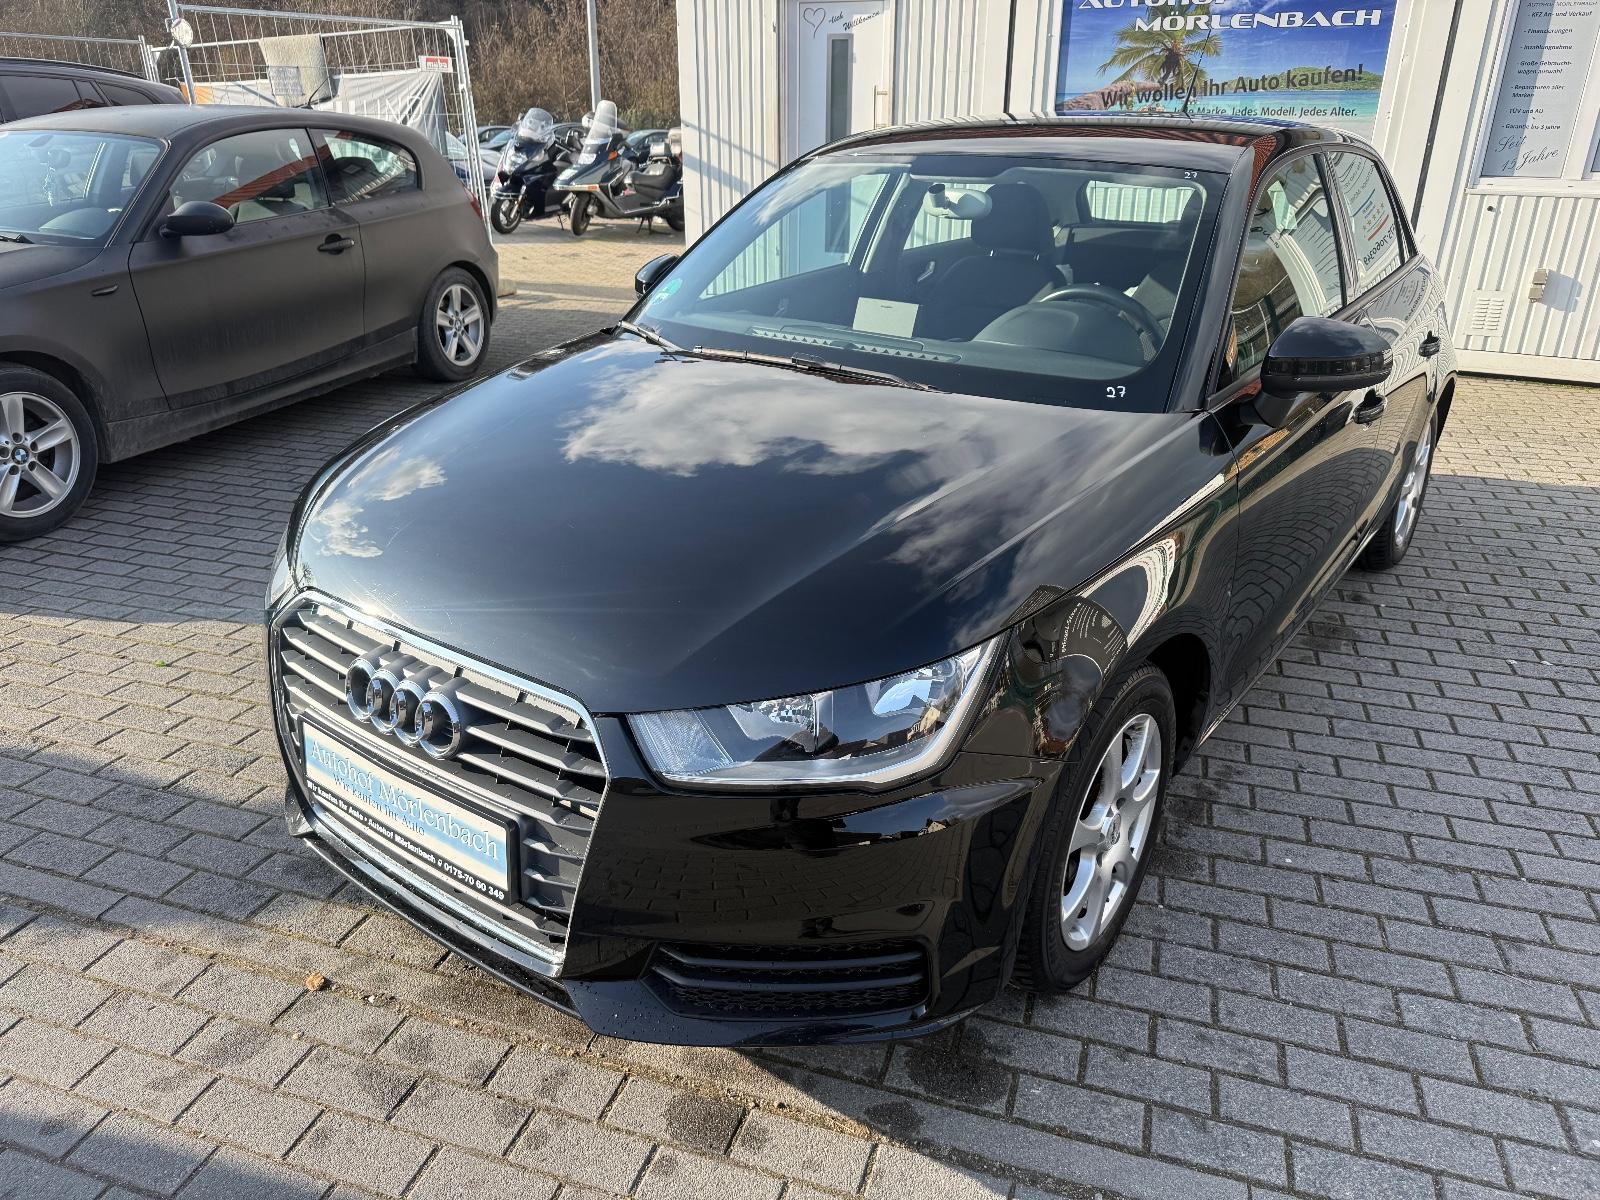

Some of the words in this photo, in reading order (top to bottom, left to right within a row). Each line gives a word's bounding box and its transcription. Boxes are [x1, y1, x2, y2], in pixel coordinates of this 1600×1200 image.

[1134, 9, 1382, 32] MÖRLENBACH
[1100, 87, 1131, 110] Wir
[1135, 82, 1197, 103] wollen
[1203, 78, 1228, 97] Ihr
[1233, 74, 1280, 93] Auto
[1286, 63, 1364, 89] kaufen!
[1260, 106, 1297, 117] Modell.
[1299, 106, 1328, 118] Jedes
[1330, 106, 1358, 117] Alter.
[1184, 171, 1198, 179] 27
[1106, 385, 1126, 398] 27
[311, 740, 375, 794] Autohof
[378, 780, 498, 862] Mörlenbach
[401, 814, 425, 836] Auto
[368, 818, 394, 839] Autohof
[394, 833, 436, 864] Mörlenbach
[443, 862, 475, 885] 0175-70
[475, 880, 487, 892] 60
[488, 888, 505, 901] 349
